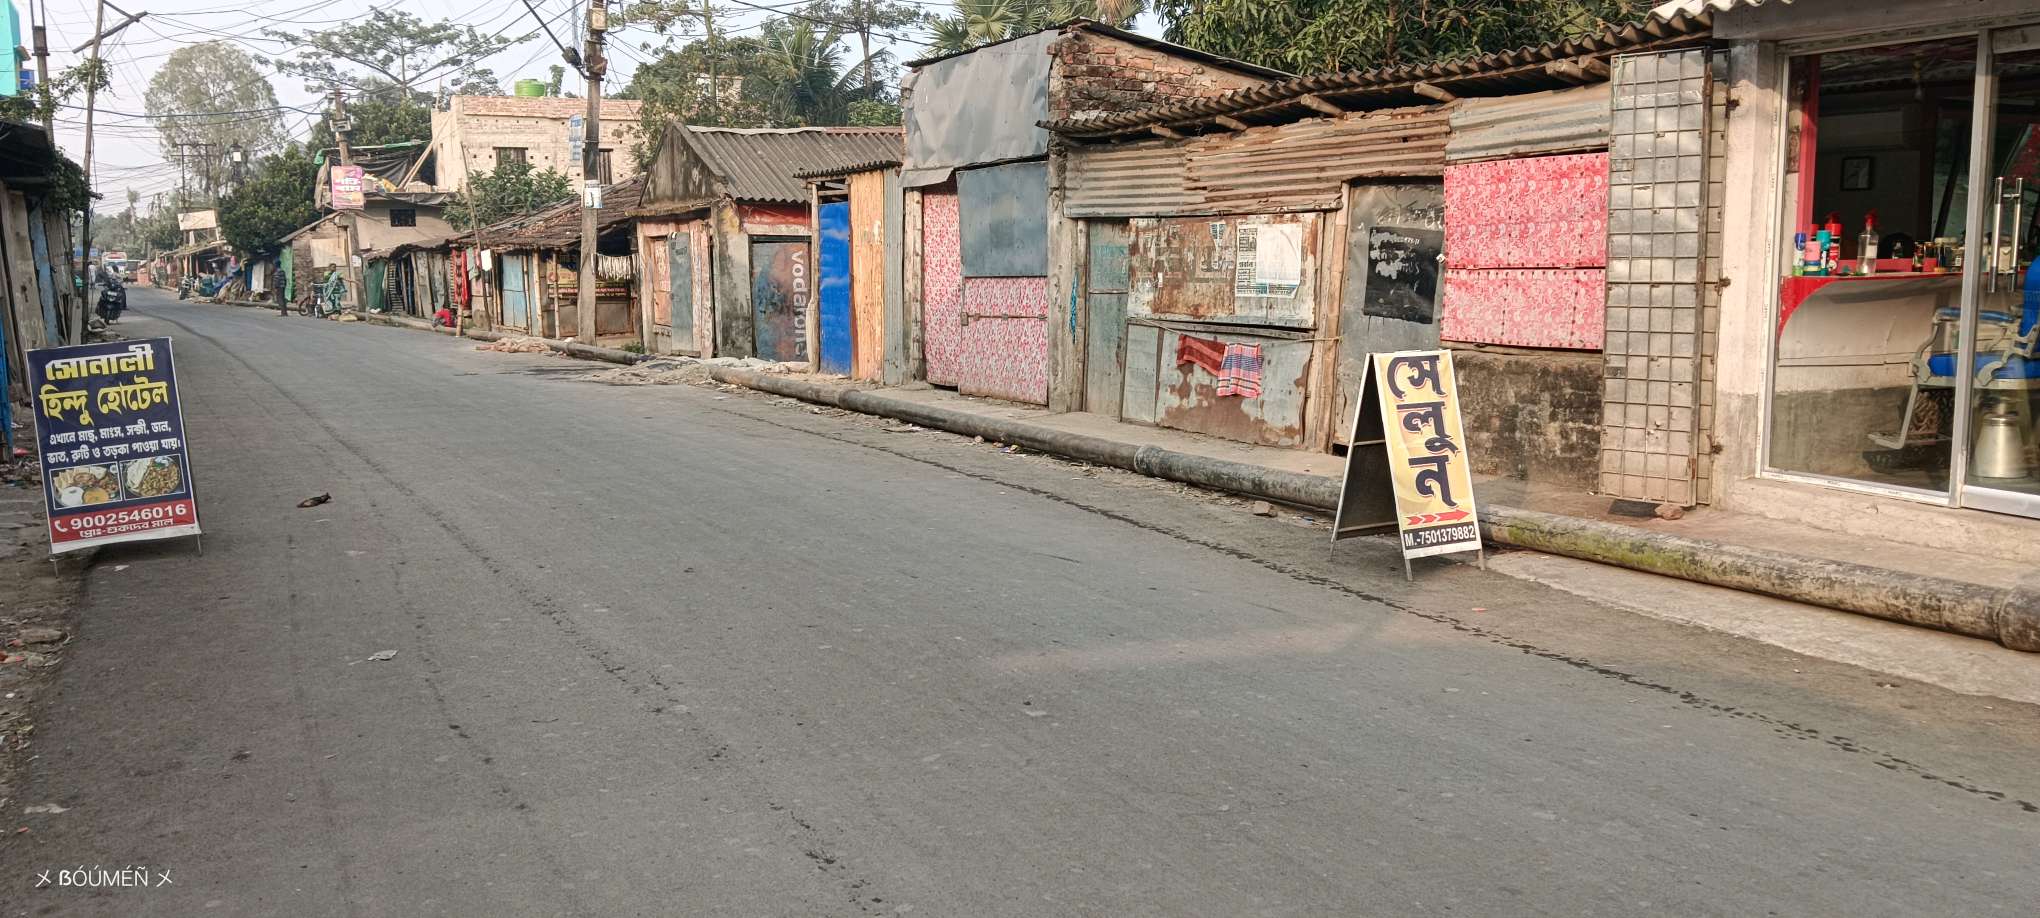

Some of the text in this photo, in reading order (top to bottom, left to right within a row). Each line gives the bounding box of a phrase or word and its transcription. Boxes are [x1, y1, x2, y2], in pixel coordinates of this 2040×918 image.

[45, 343, 154, 381] সোনালী
[39, 375, 169, 426] হিন্দু হোটেল
[49, 431, 76, 445] এখানে
[70, 444, 90, 462] রুটি
[92, 447, 101, 458] ও
[70, 503, 187, 530] 9002546016
